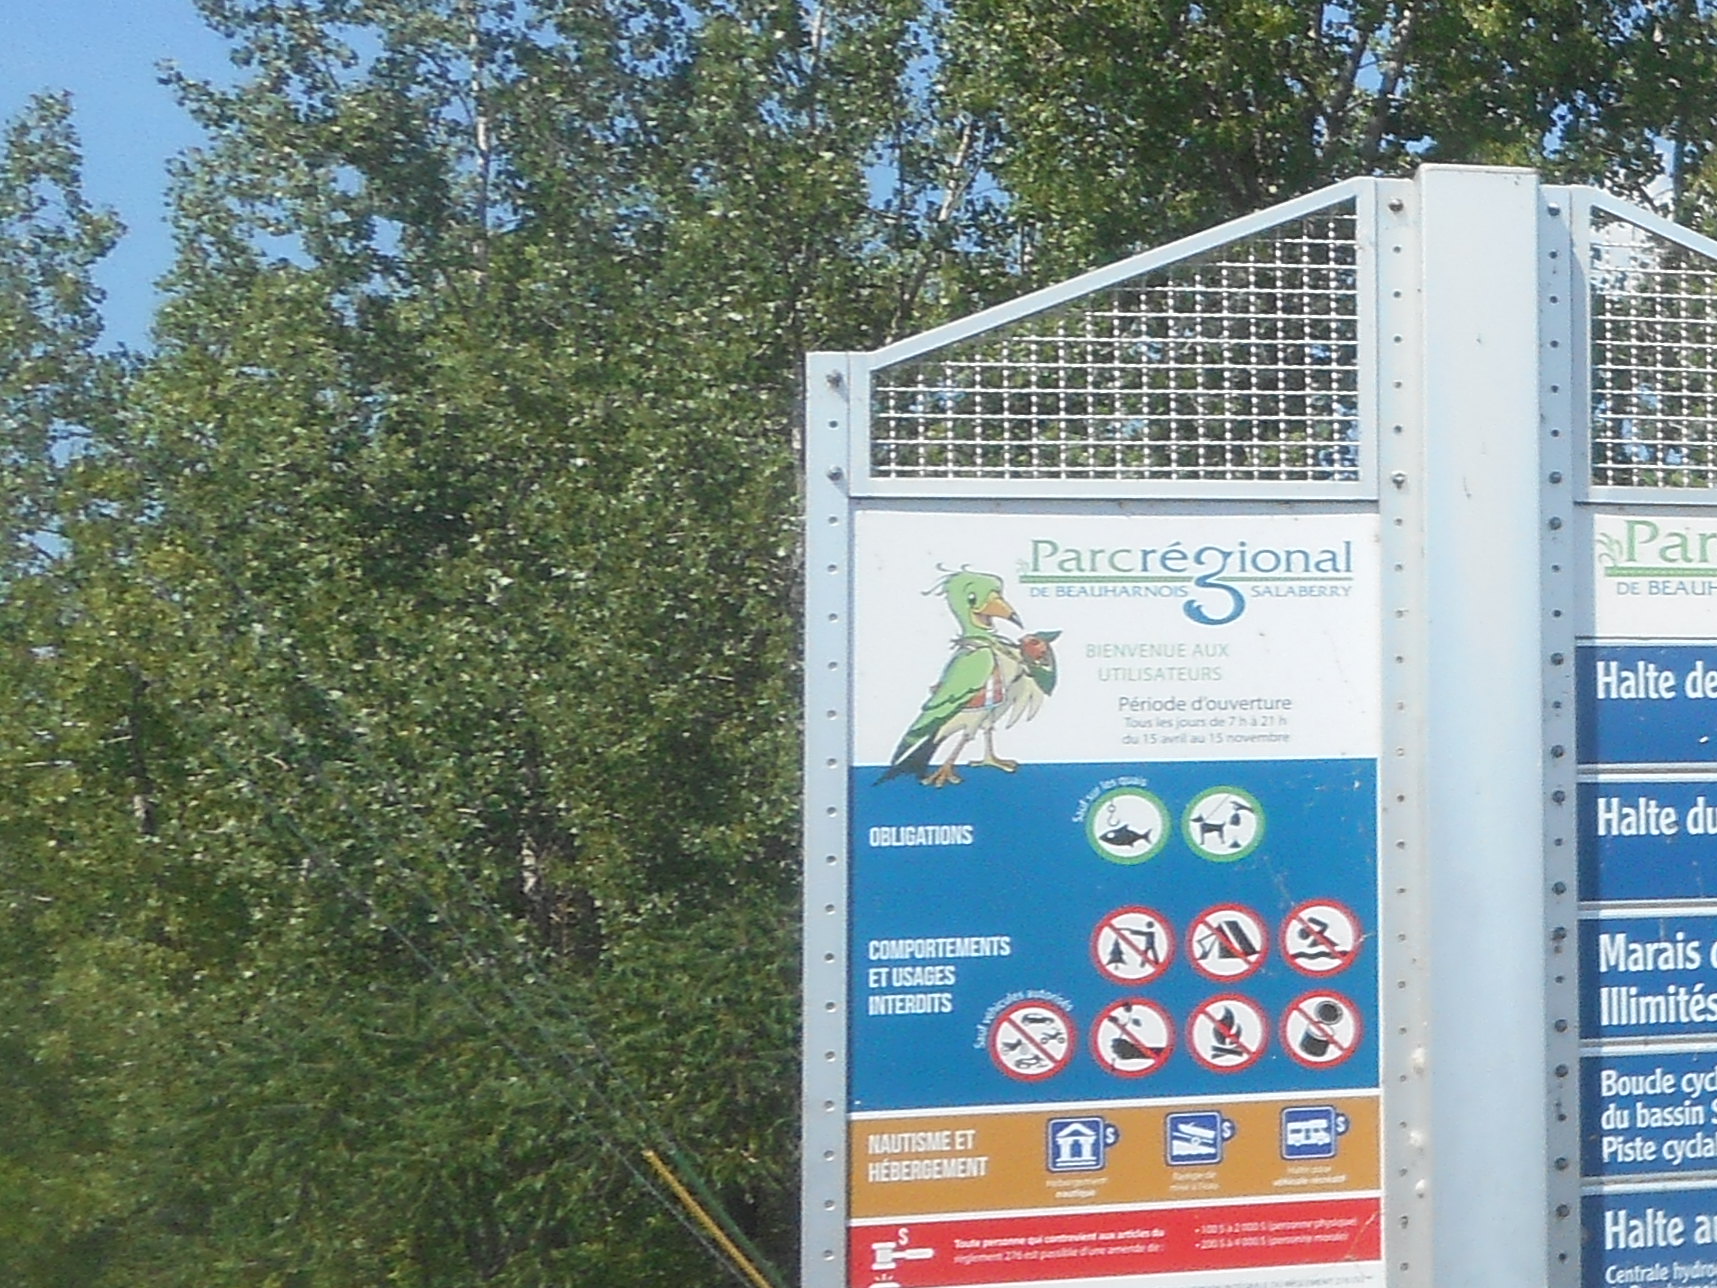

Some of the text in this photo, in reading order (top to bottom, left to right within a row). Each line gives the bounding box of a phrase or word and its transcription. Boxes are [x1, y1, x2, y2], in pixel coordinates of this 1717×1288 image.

[1030, 585, 1352, 598] DE BEAUHARNOIS SALABERRY
[1616, 581, 1640, 596] DE
[1086, 643, 1229, 658] BIENVENUE AUX
[1098, 666, 1222, 682] UTILISATEURS
[1596, 661, 1676, 700] Halte
[1118, 696, 1186, 712] Période
[1124, 716, 1152, 728] Tous
[1156, 716, 1173, 728] les
[1176, 716, 1206, 730] jours
[1209, 716, 1225, 727] de
[1261, 716, 1274, 727] 21
[1121, 732, 1290, 744] du 15 avril au 15 novembre
[1598, 797, 1678, 836] Halte
[869, 825, 974, 846] OBLIGATIONS
[868, 936, 1011, 960] COMPORTEMENTS
[1599, 932, 1699, 972] Marais
[868, 965, 956, 988] ET USAGES
[868, 993, 953, 1016] INTERDITS
[1601, 1069, 1675, 1098] Boucle
[1601, 1103, 1631, 1130] du
[1636, 1098, 1705, 1127] bassin
[868, 1129, 976, 1155] NAUTISME ET
[1602, 1134, 1656, 1164] Piste
[868, 1156, 989, 1183] HÉBERGEMENT
[1604, 1208, 1685, 1250] Halte
[982, 1237, 1026, 1248] personne
[1605, 1261, 1669, 1286] Centrale
